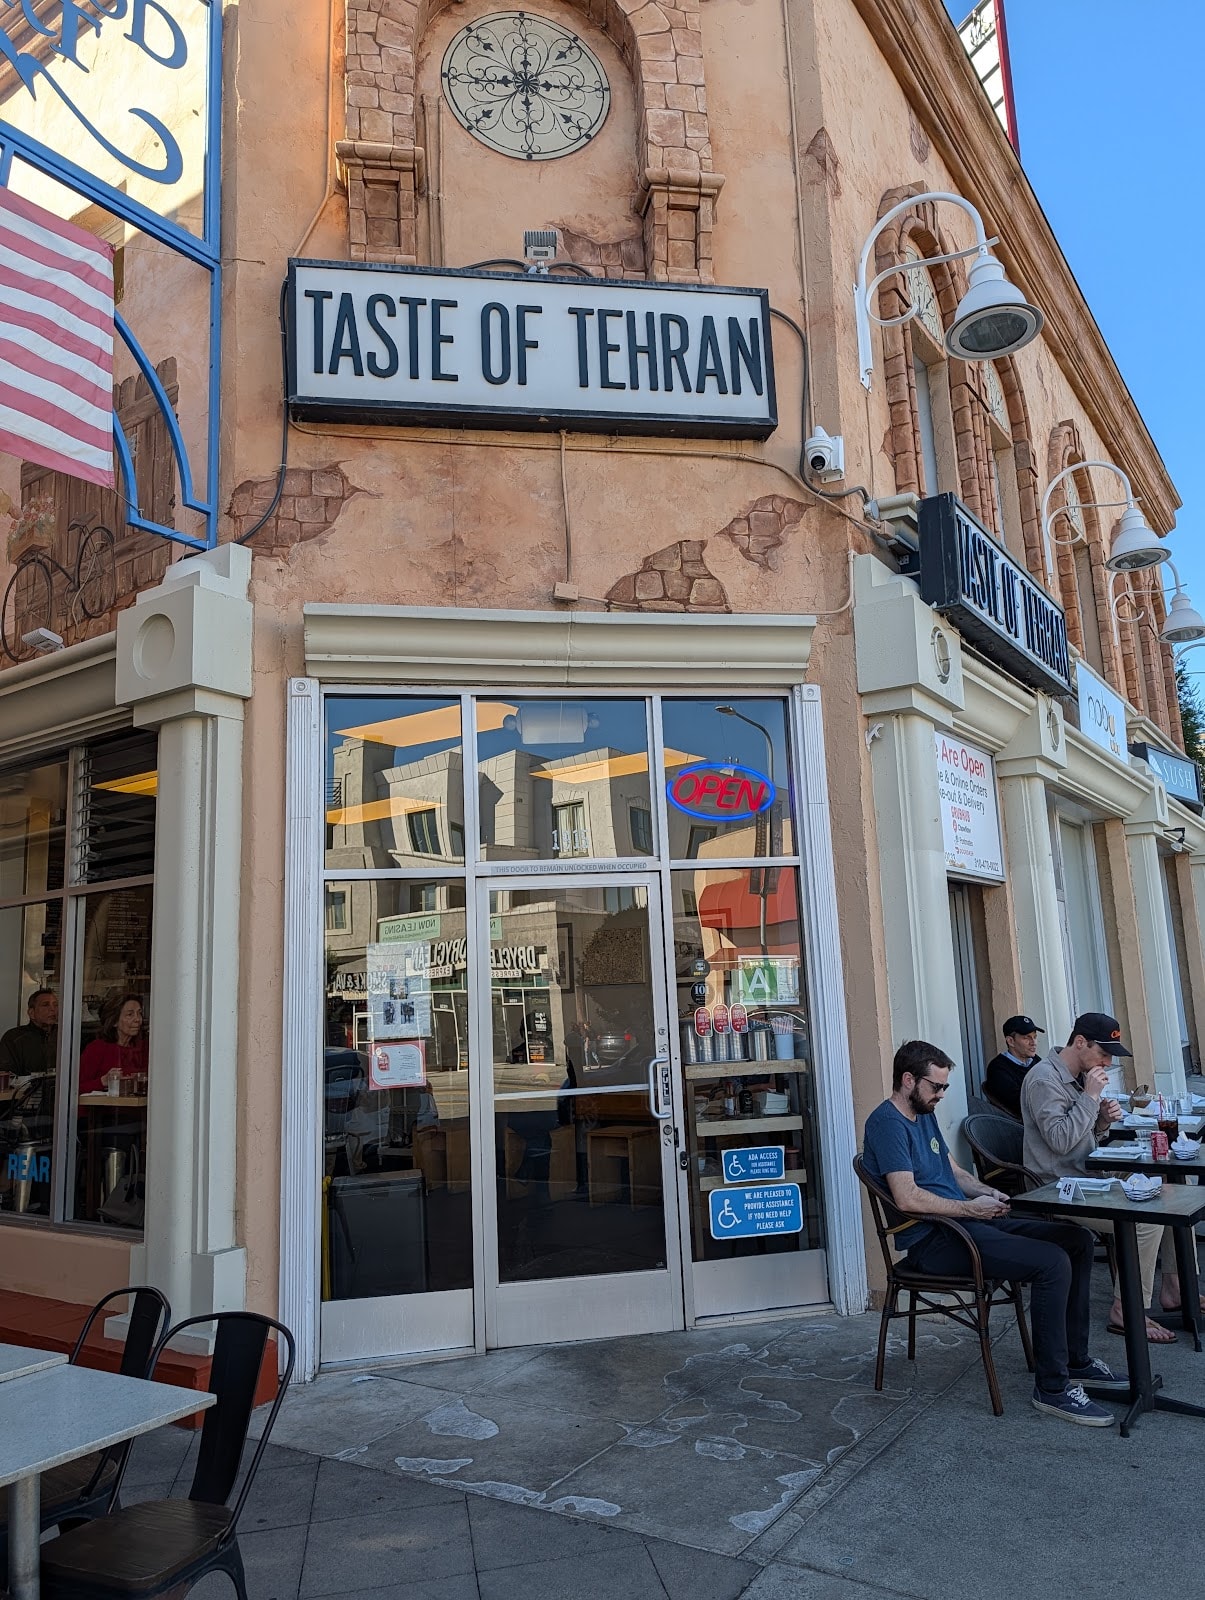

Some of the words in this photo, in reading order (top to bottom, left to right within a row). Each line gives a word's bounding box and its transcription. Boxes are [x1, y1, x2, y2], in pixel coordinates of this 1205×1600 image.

[304, 289, 459, 381] TASTE
[480, 302, 542, 385] OF
[568, 306, 764, 395] TEHRAN
[956, 514, 1004, 625] TASTE
[1001, 562, 1019, 638] OF
[1021, 580, 1071, 687] TEHRAN
[941, 739, 959, 767] Are
[961, 748, 986, 778] Open
[672, 773, 767, 811] OPEN
[945, 770, 950, 784] &
[951, 772, 969, 791] Online
[970, 780, 988, 798] Orders
[963, 793, 985, 815] Delivery
[539, 864, 564, 872] REMAIN
[617, 862, 648, 870] OCCUPIED
[749, 968, 771, 993] A
[748, 1153, 759, 1161] ADA
[760, 1152, 778, 1160] ACCESS
[8, 1153, 50, 1183] REAR
[744, 1192, 752, 1200] WE
[753, 1191, 763, 1199] ARE
[764, 1190, 785, 1198] PLEASED
[785, 1189, 792, 1197] TO
[1062, 1184, 1072, 1196] 48
[744, 1202, 764, 1210] PROVIDE
[765, 1199, 794, 1208] ASSISTANCE
[754, 1212, 765, 1220] YOU
[765, 1211, 778, 1219] NEED
[779, 1210, 791, 1218] HELP
[756, 1221, 774, 1230] PLEASE
[775, 1221, 785, 1229] ASK
